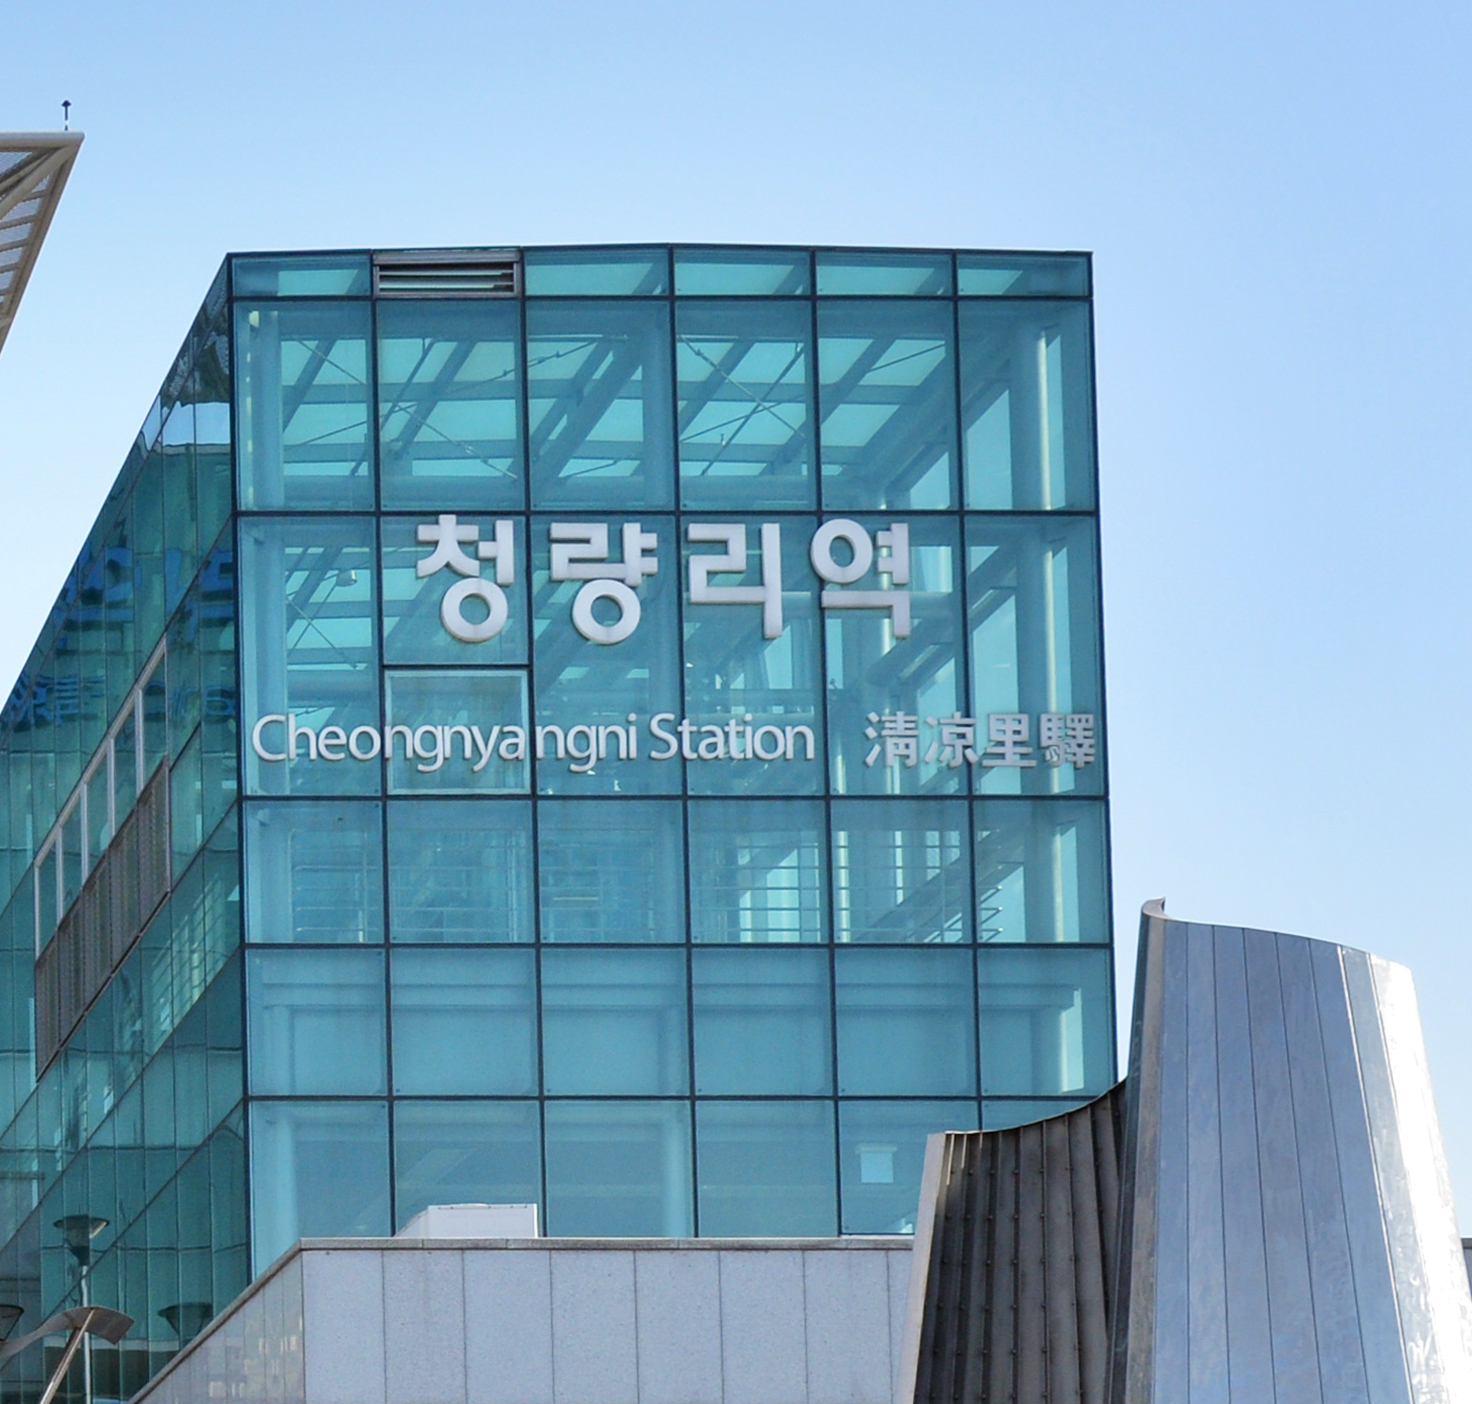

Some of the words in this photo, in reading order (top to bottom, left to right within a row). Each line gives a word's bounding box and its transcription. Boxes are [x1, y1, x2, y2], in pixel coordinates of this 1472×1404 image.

[417, 514, 910, 645] 청량리역
[252, 713, 638, 772] Cheongnyangni
[649, 712, 815, 764] Station
